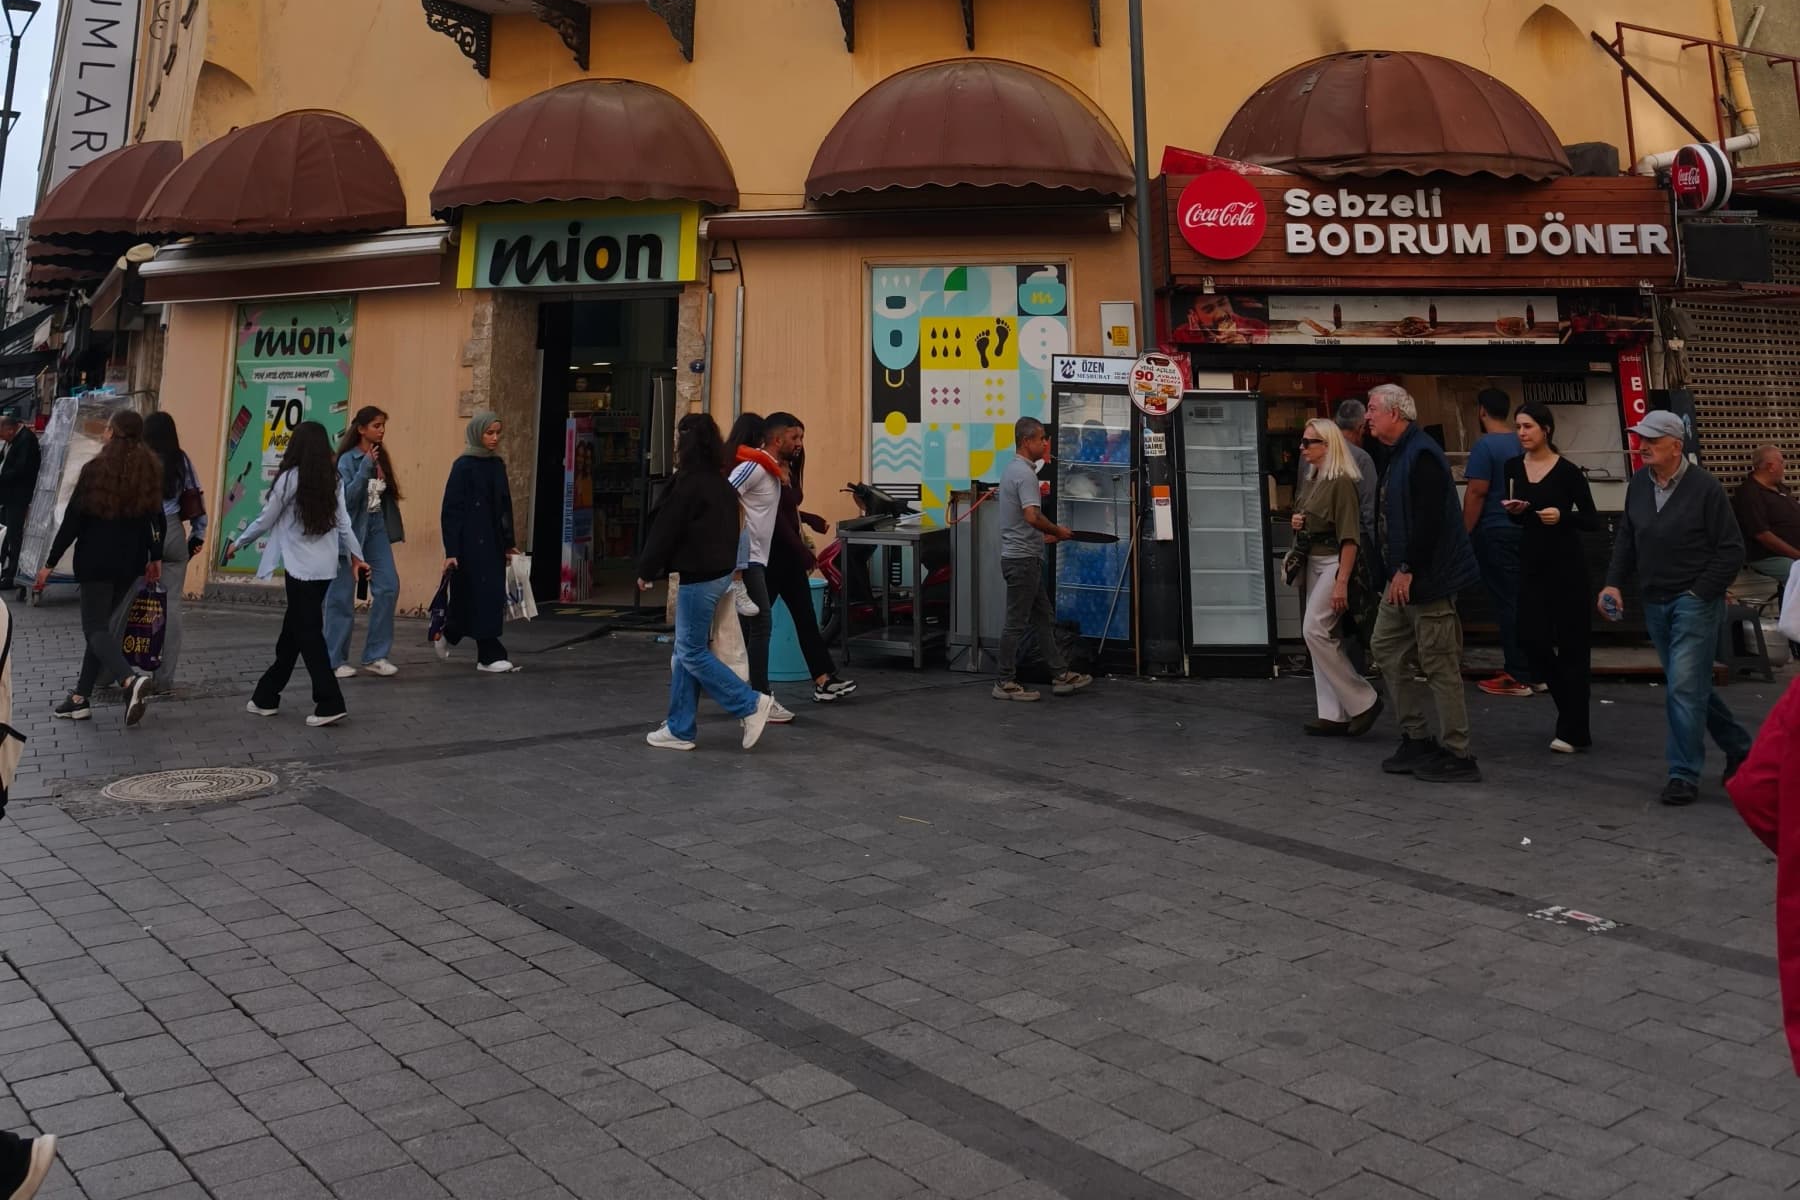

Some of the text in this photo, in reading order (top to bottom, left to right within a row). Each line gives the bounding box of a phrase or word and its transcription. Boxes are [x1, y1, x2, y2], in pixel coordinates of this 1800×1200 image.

[1185, 201, 1258, 228] Coca-Cola
[1283, 187, 1443, 218] Sebzeli
[1285, 211, 1672, 257] BODRUM DÖNER
[489, 221, 663, 286] mion
[254, 317, 335, 357] mion
[1081, 359, 1105, 373] ÖZEN
[1135, 370, 1154, 381] 90
